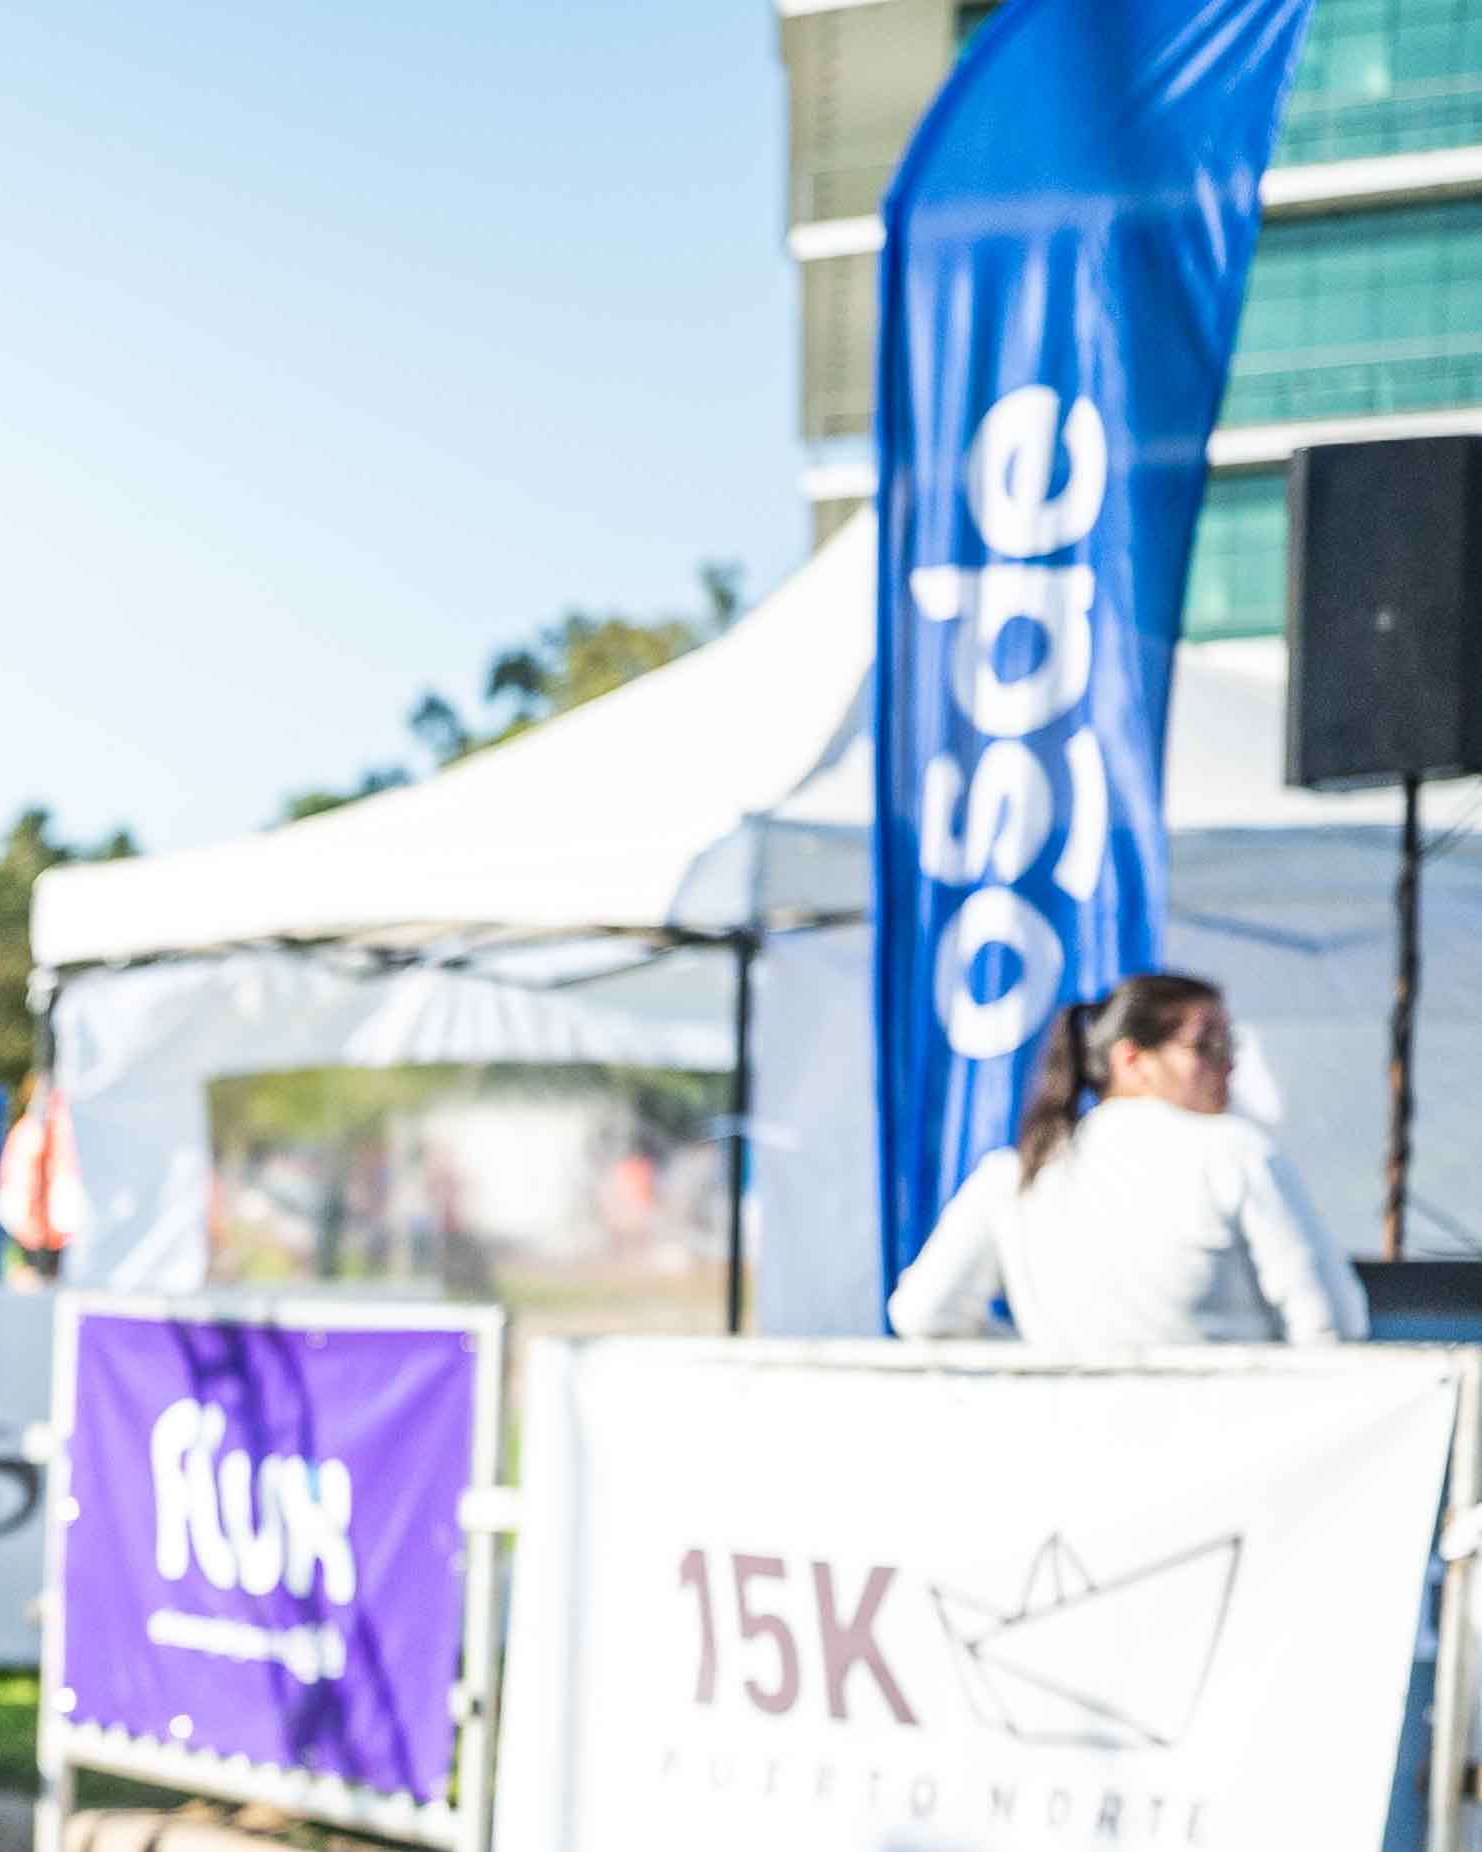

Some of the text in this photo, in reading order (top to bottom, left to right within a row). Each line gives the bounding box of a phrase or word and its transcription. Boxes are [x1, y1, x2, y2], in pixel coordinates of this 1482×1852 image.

[911, 383, 1108, 1060] osde
[678, 1547, 921, 1727] 15K
[989, 1785, 1211, 1846] NORTE
